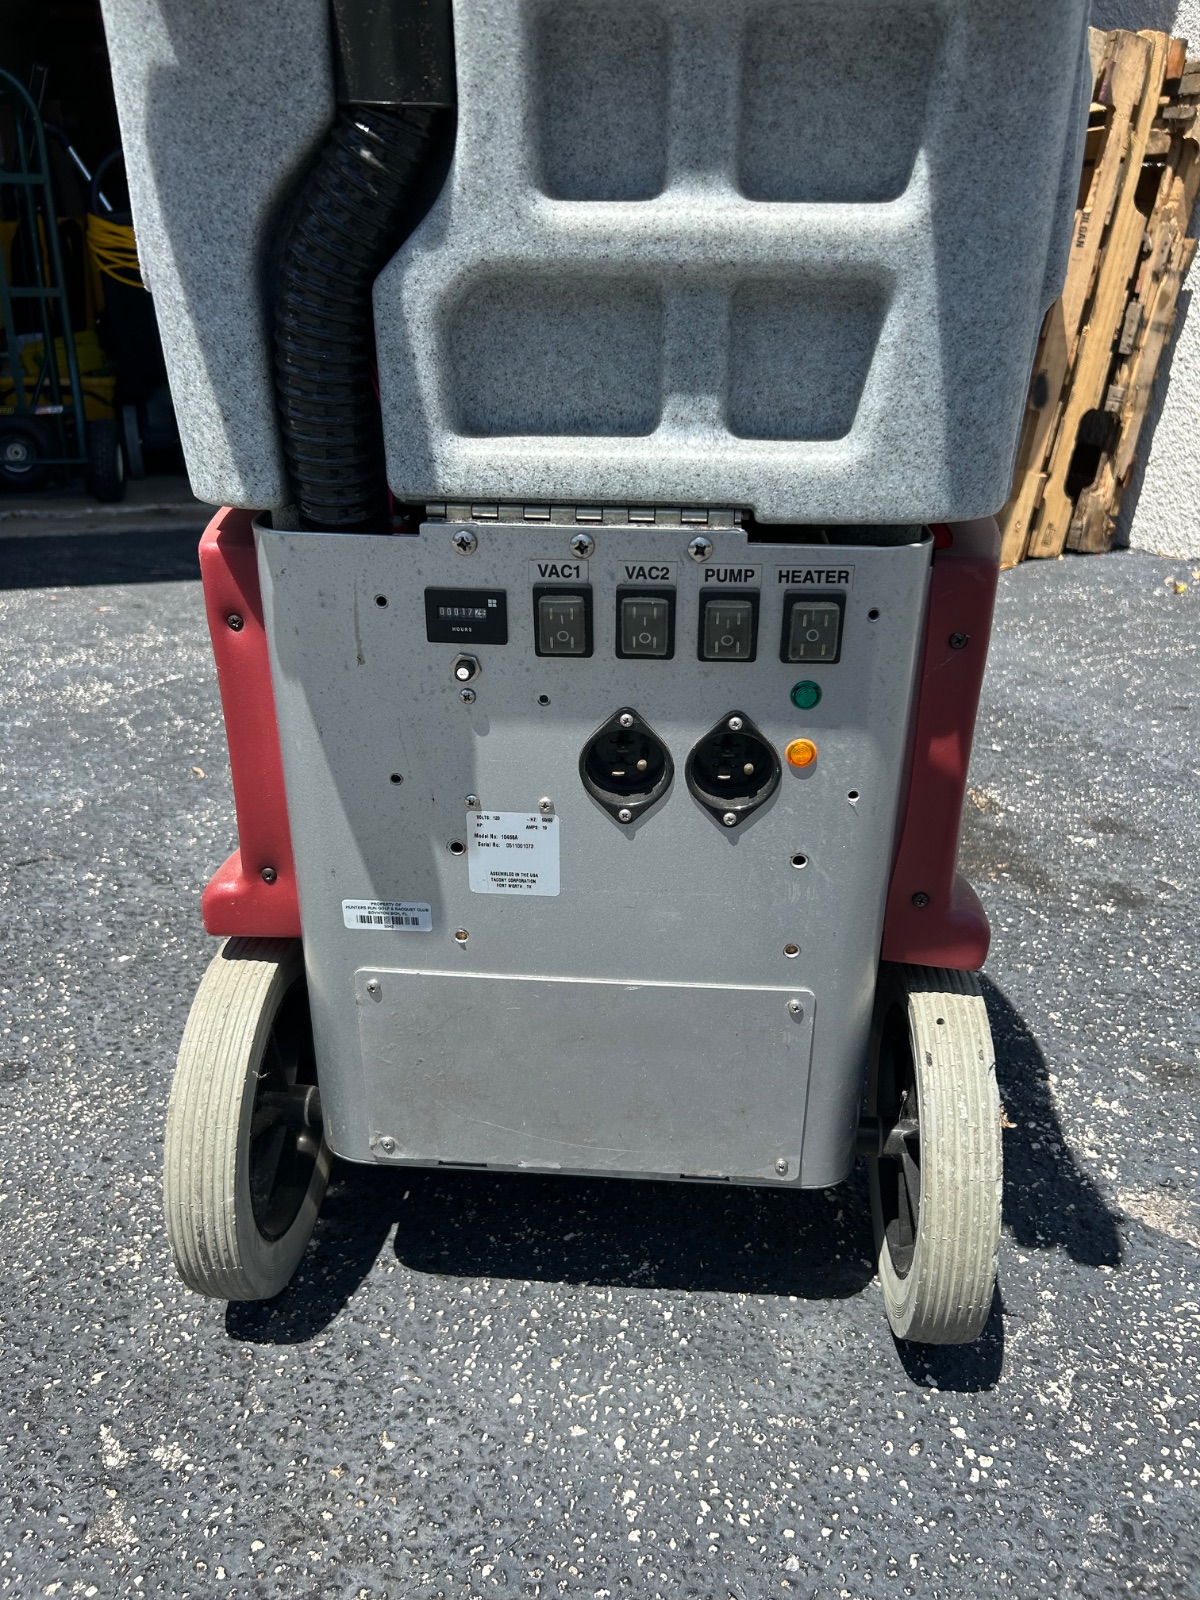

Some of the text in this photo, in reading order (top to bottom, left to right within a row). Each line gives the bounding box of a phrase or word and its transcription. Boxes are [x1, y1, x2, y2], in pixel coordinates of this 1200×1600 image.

[537, 564, 580, 579] VAC1
[625, 566, 670, 580] VAC2
[704, 568, 755, 583] PUMP
[778, 570, 850, 584] HEATER
